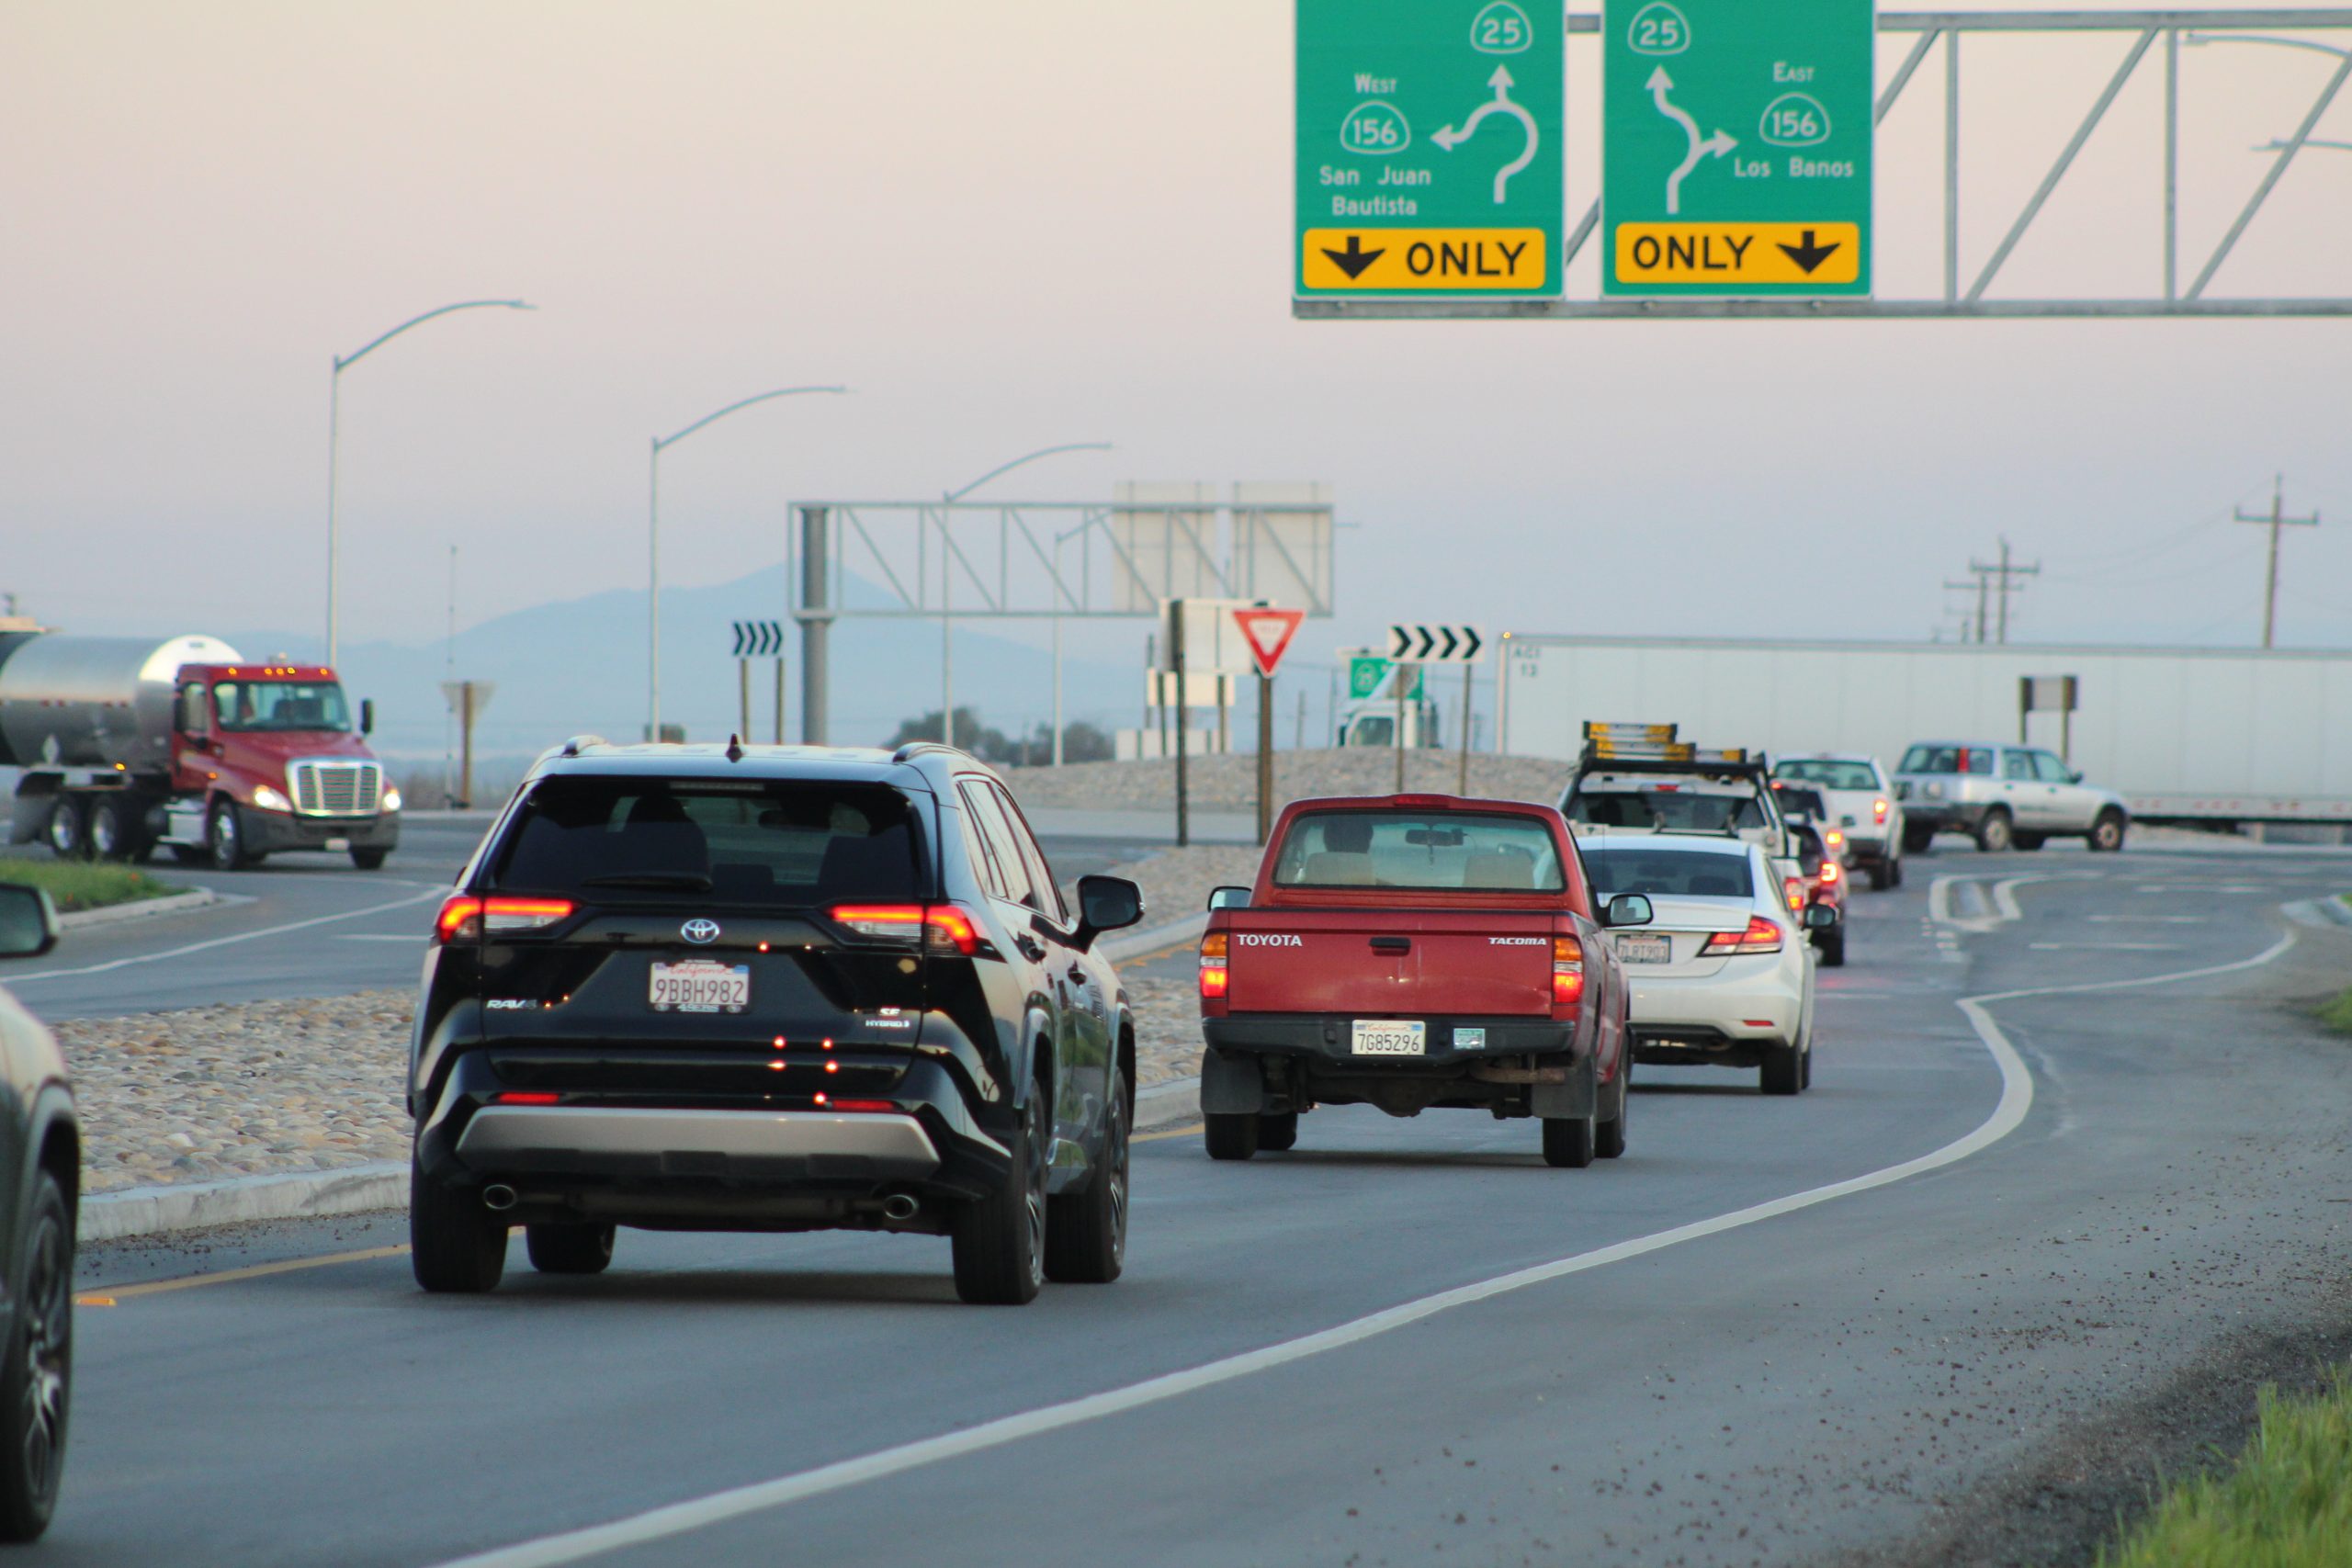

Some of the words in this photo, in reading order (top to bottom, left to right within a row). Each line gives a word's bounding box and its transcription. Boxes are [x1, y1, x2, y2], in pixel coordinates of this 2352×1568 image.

[1482, 18, 1521, 45] 25
[1639, 19, 1679, 46] 25
[1772, 61, 1815, 83] EAST
[1353, 73, 1397, 94] WEST
[1352, 118, 1398, 145] 156
[1771, 111, 1818, 138] 156
[1319, 165, 1360, 186] San
[1377, 165, 1431, 186] Juan
[1734, 156, 1771, 177] Los
[1789, 156, 1854, 177] Banos
[1332, 196, 1418, 216] Bautista
[1406, 242, 1528, 276] ONLY
[1633, 235, 1755, 271] ONLY
[1236, 933, 1303, 947] TOYOTA
[1487, 937, 1547, 946] TACOMA
[654, 978, 745, 1004] 9BBH982
[486, 998, 538, 1010] RAV4
[865, 1020, 903, 1028] HYBRID
[1356, 1033, 1420, 1053] 7G85296
